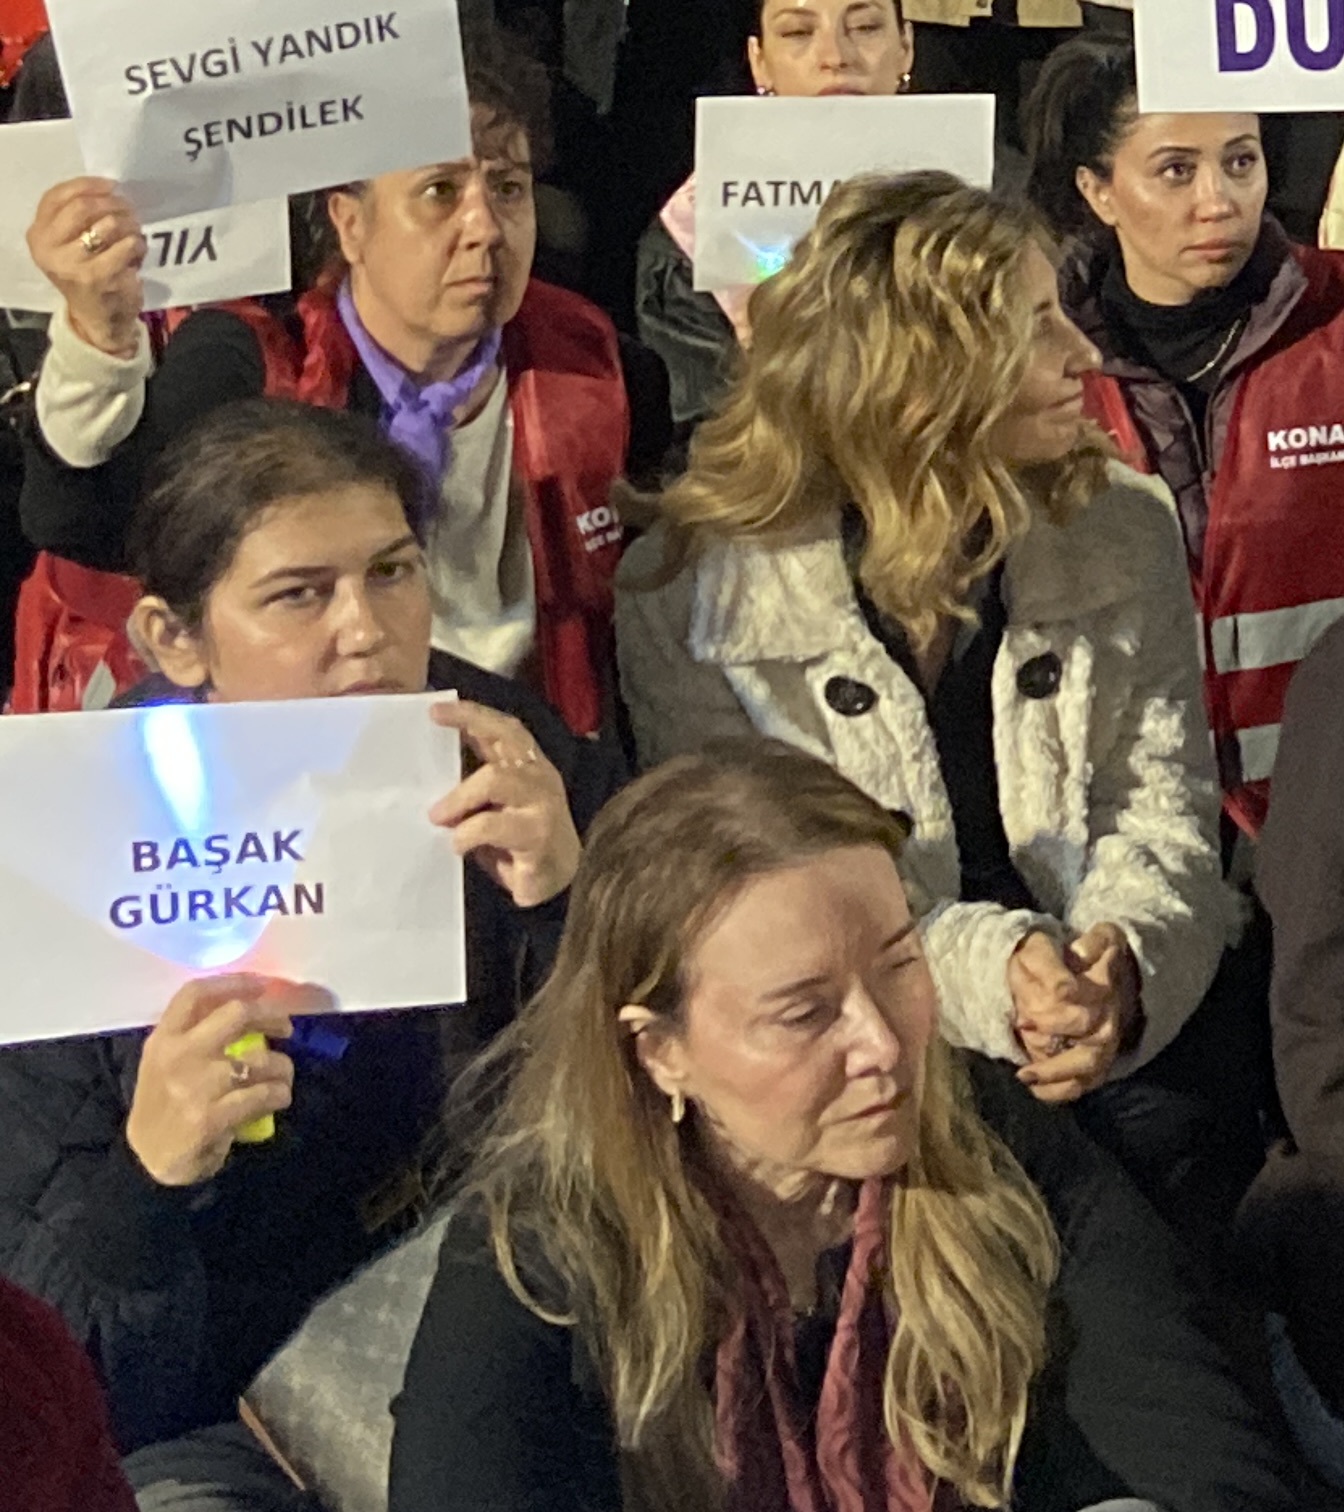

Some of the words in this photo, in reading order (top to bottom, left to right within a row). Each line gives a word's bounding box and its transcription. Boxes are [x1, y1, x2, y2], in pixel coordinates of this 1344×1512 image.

[124, 37, 240, 96] SEVGİ
[251, 11, 400, 68] YANDIK
[183, 94, 365, 163] ŞENDİLEK
[722, 179, 842, 207] FATM
[147, 225, 218, 268] YIL
[576, 505, 620, 535] KO
[131, 829, 304, 875] BAŞAK
[109, 883, 324, 929] GÜRKAN
